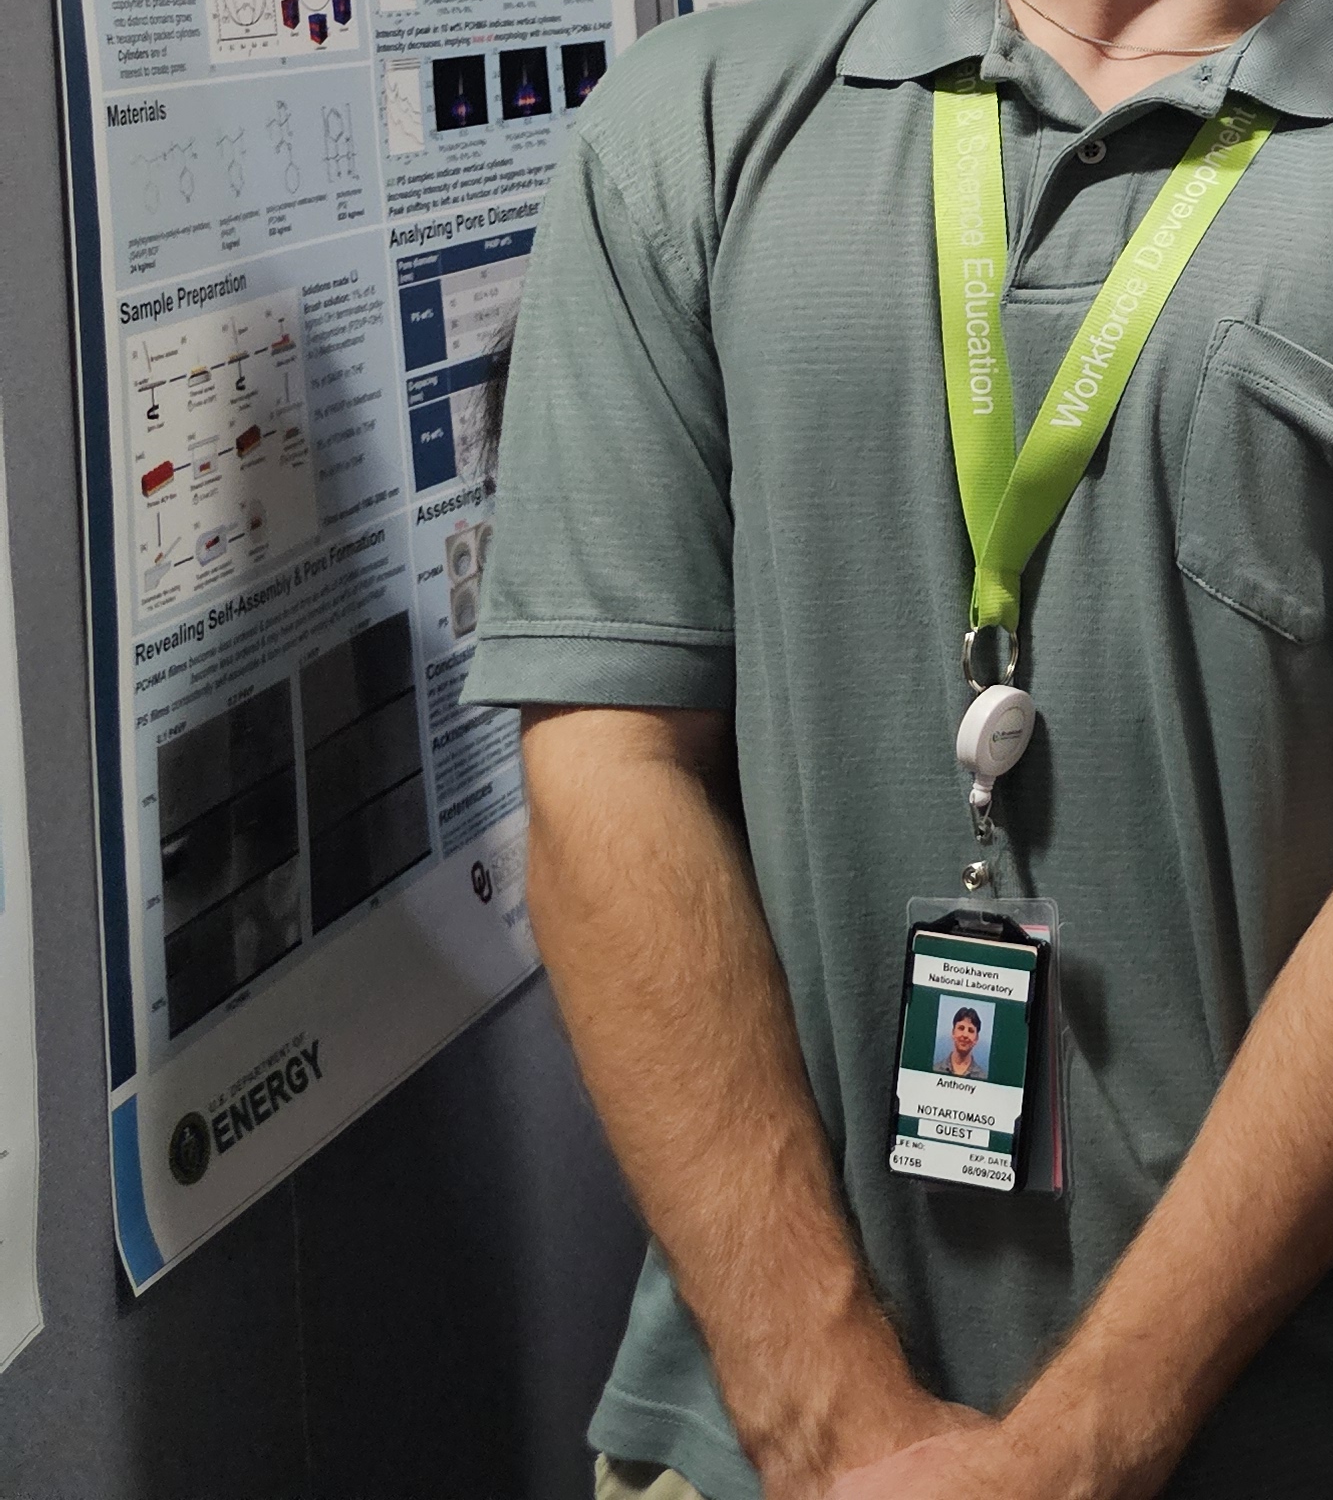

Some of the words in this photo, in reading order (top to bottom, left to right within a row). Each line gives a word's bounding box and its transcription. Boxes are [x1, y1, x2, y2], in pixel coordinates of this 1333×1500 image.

[106, 99, 168, 128] Materials
[956, 108, 984, 128] &
[956, 132, 990, 248] Science
[389, 218, 454, 250] Analyzing
[455, 213, 486, 234] Pore
[487, 200, 540, 226] Diameter
[1048, 275, 1151, 430] Workforce
[1134, 105, 1258, 274] Development
[120, 293, 174, 325] Sample
[176, 272, 248, 310] Preparation
[961, 255, 995, 417] Education
[415, 485, 485, 526] Assessing
[134, 618, 205, 666] Revealing
[207, 572, 292, 631] Self-Assembly
[293, 568, 303, 587] &
[303, 552, 329, 578] Pore
[328, 528, 386, 568] Formation
[942, 961, 999, 980] Brookhaven
[928, 972, 964, 987] National
[965, 978, 1014, 997] Laboratory
[211, 1038, 323, 1157] ENERGY
[936, 1077, 977, 1095] Anthony
[916, 1103, 996, 1127] NOTARTOMASO
[935, 1124, 974, 1140] GUEST
[893, 1153, 922, 1168] 6175B
[969, 1153, 986, 1164] EXP.
[961, 1163, 1013, 1183] 08/09/2024
